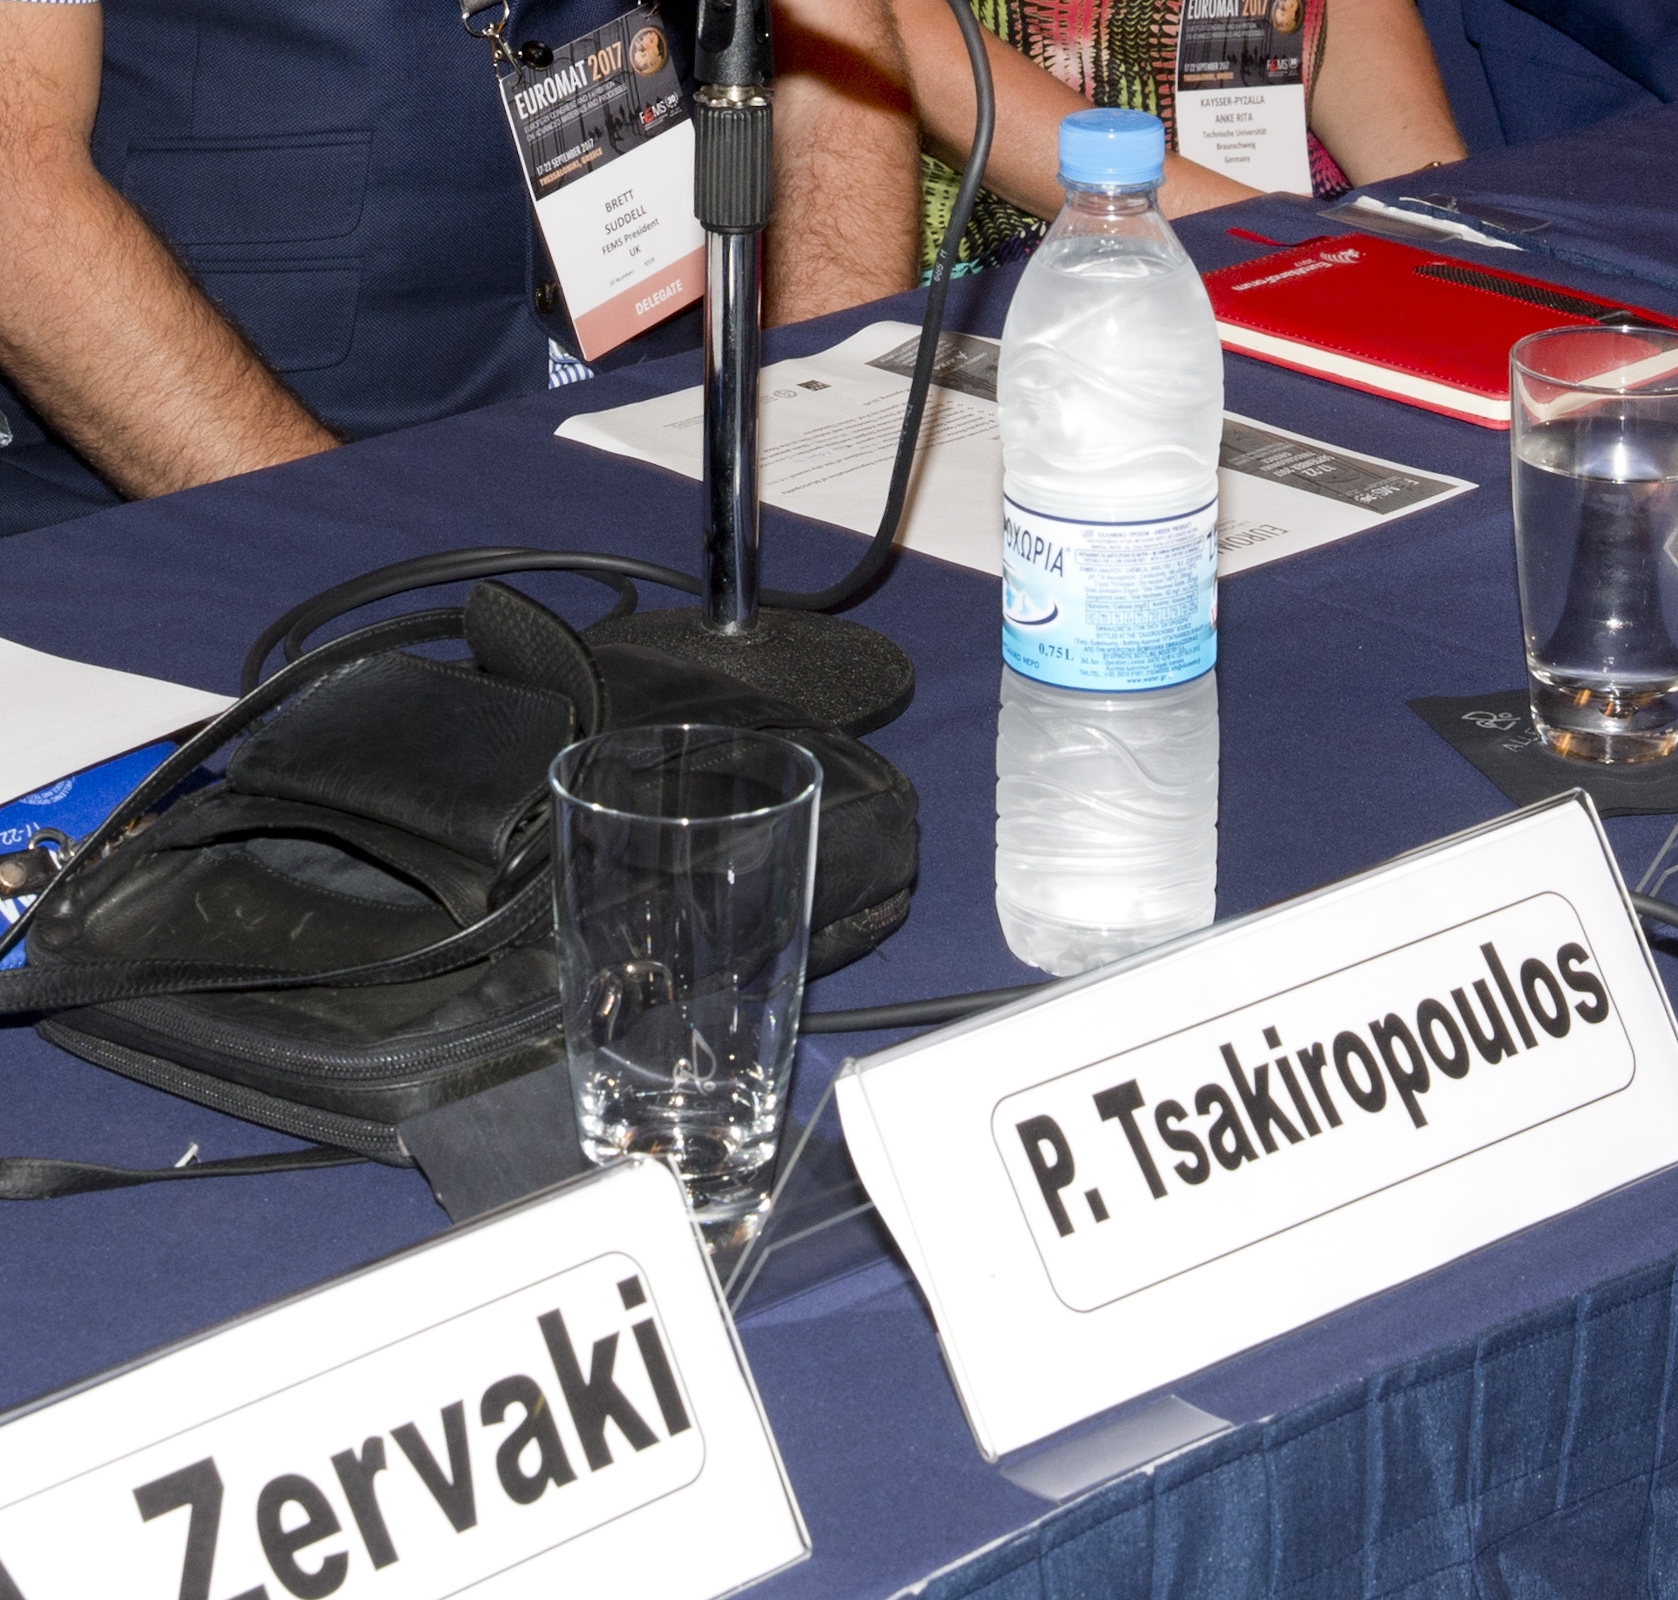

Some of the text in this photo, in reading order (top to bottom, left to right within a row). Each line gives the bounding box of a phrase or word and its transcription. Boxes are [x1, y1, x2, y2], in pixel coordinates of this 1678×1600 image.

[514, 41, 622, 120] EUROMAT 2017
[639, 100, 667, 125] FEMS
[1201, 95, 1265, 107] KAYSSER-PYZALLA
[1215, 113, 1253, 123] ANKE RITA
[1203, 127, 1267, 139] Technische Universität
[550, 145, 581, 168] SEPTEMBER
[580, 138, 595, 151] 2017
[581, 147, 603, 164] GREECE
[1216, 141, 1256, 151] Braunschweig
[1224, 155, 1250, 164] Germany
[605, 189, 634, 213] BRETT
[604, 205, 647, 235] SUDDELL
[602, 218, 659, 255] FEMS President
[628, 244, 641, 257] UK
[635, 279, 683, 315] DELEGATE
[1012, 939, 1612, 1238] P. Tsakiropoulos
[132, 1273, 693, 1600] Zervaki
